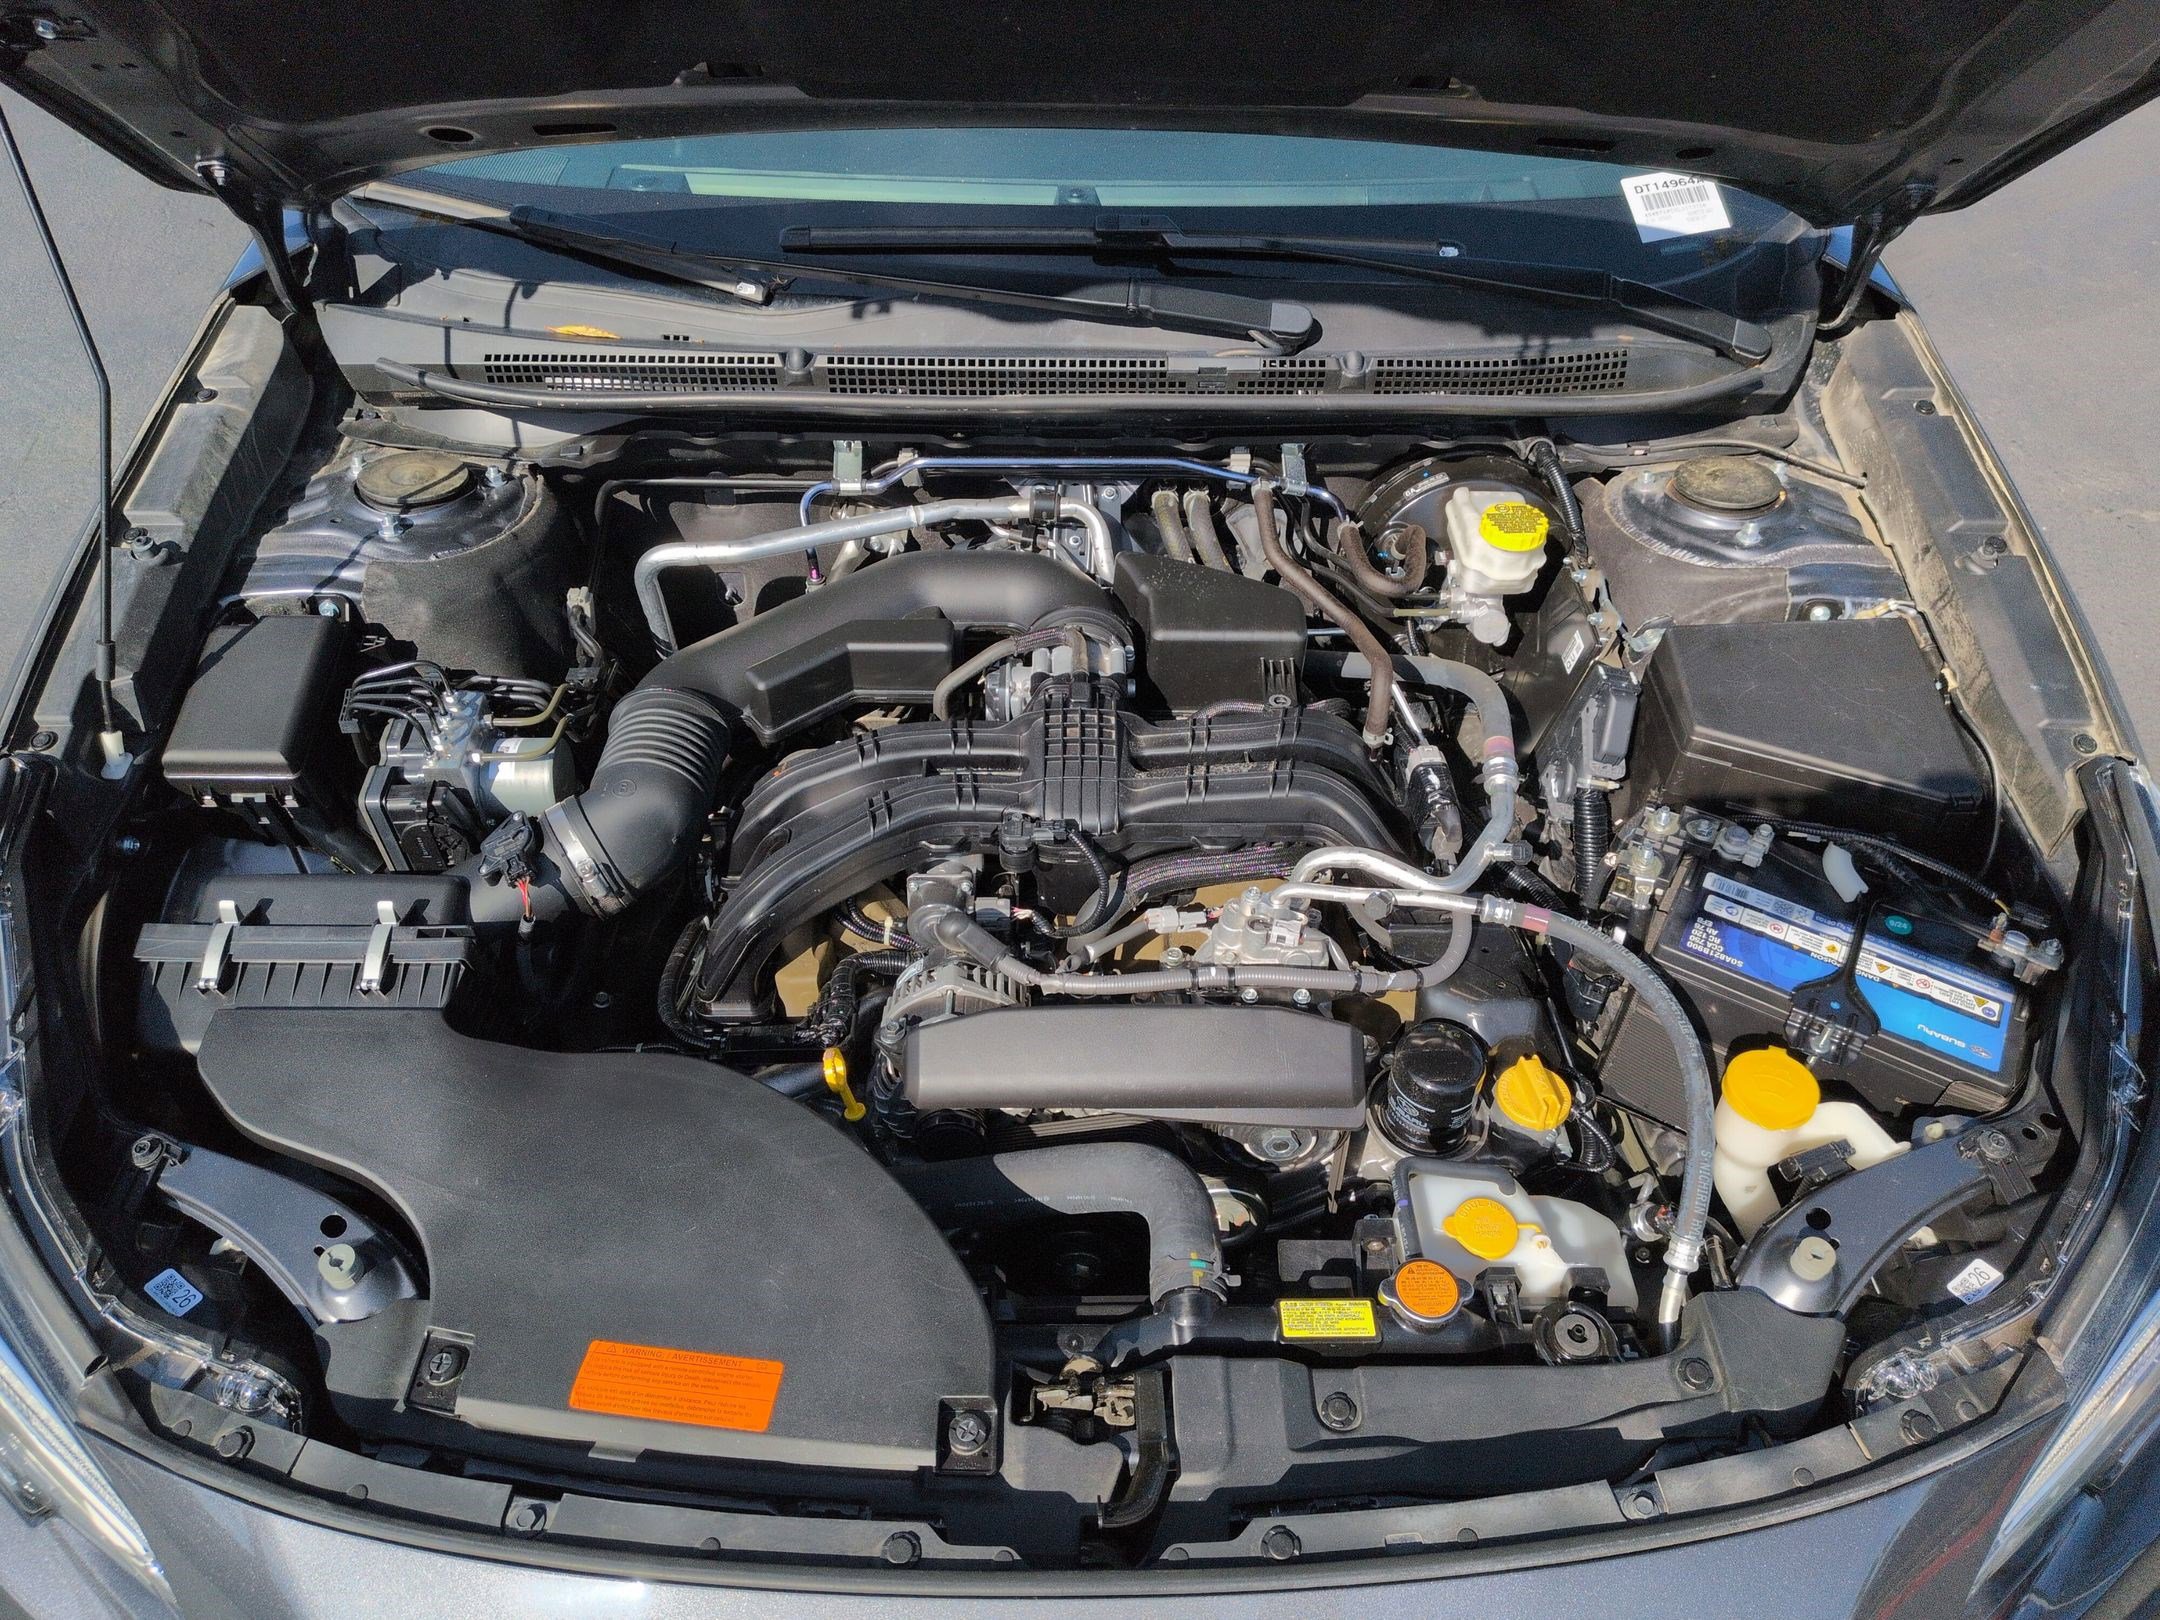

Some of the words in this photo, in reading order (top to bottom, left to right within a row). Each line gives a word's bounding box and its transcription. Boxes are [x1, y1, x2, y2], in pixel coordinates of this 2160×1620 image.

[1917, 1023, 1966, 1048] SUBARU
[1969, 1266, 1991, 1287] 26
[172, 1289, 197, 1308] 26
[671, 1352, 743, 1367] AVERTISSEMENT
